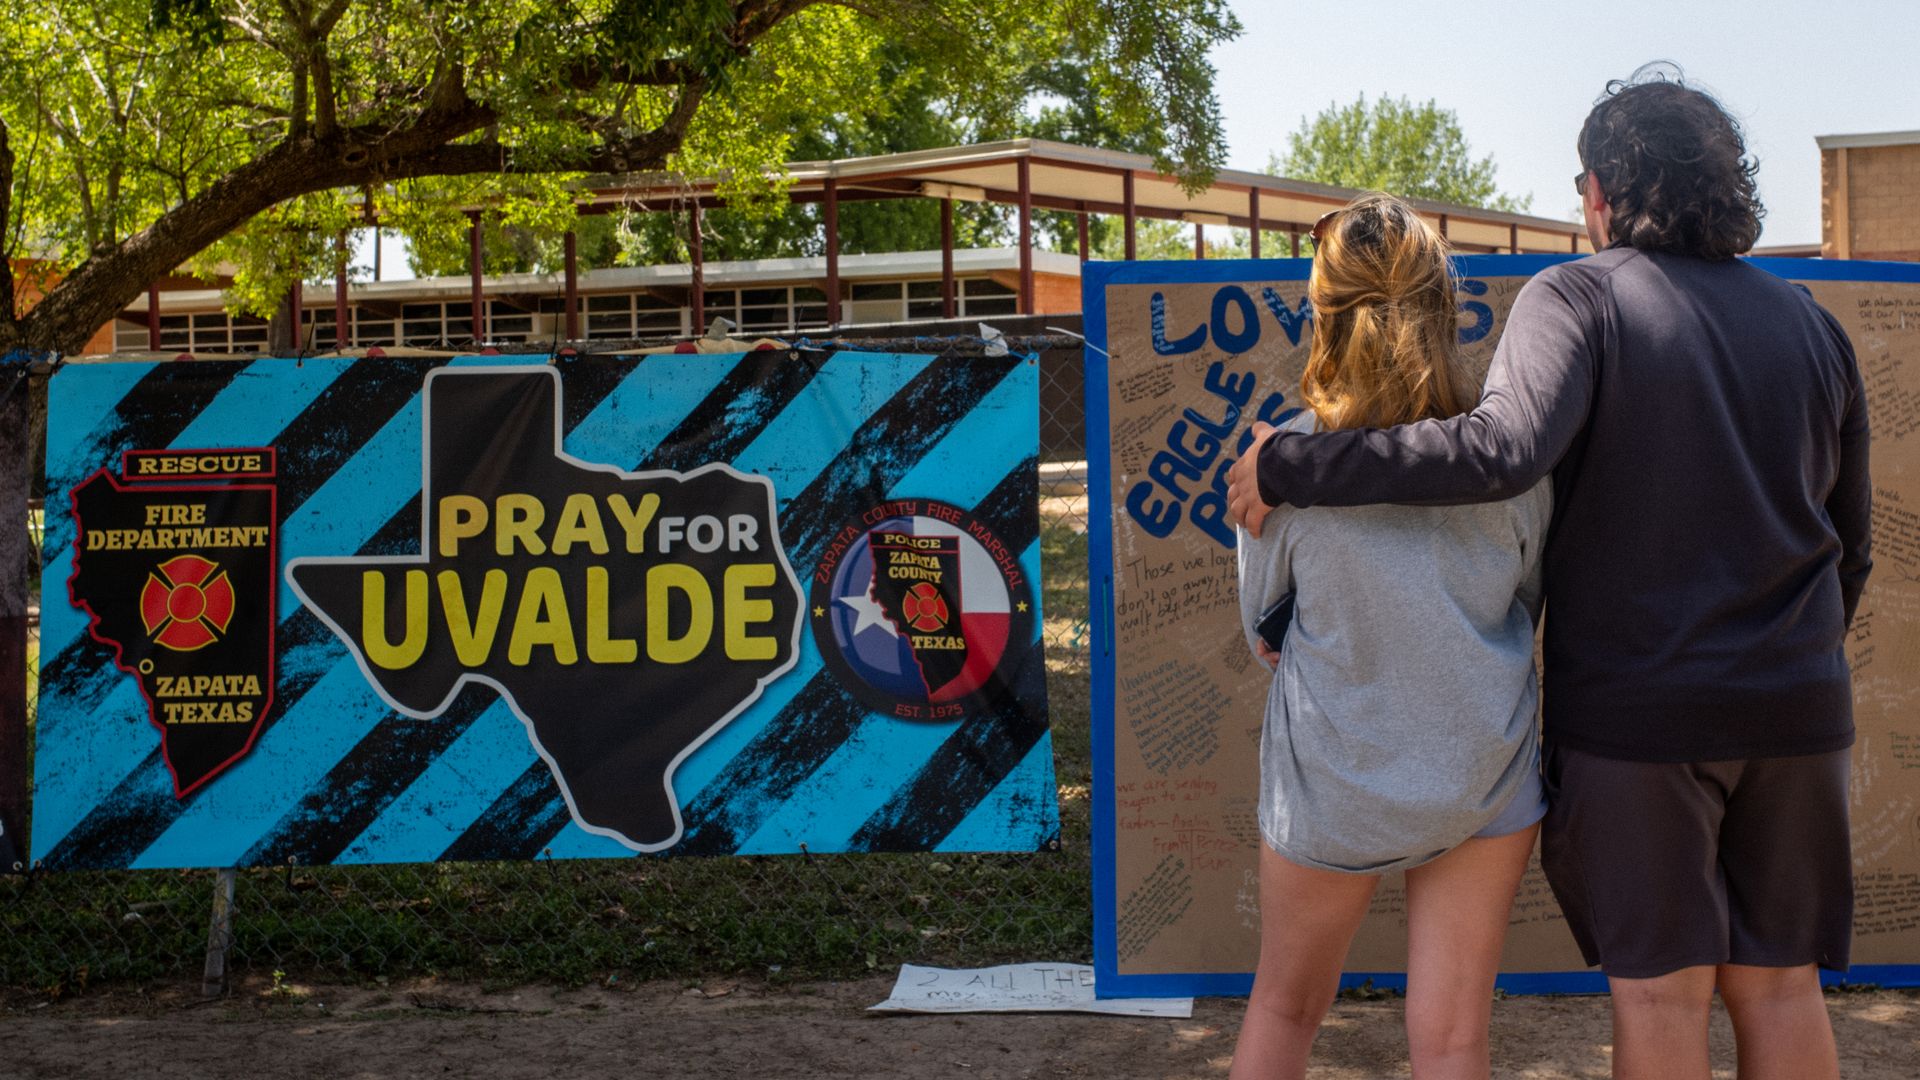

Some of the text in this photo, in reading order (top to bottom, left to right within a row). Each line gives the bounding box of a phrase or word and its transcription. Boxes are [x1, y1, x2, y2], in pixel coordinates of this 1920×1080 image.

[1126, 361, 1256, 539] EAGLE
[138, 455, 262, 475] RESCUE
[145, 504, 207, 526] FIRE
[437, 492, 760, 558] PRAY FOR
[87, 526, 269, 551] DEPARTMENT
[816, 501, 1023, 591] ZAPATA COUNTY FIRE MARSHAL
[884, 534, 941, 549] POLICE
[889, 551, 941, 569] ZAPATA
[1126, 547, 1238, 589] Those we love
[888, 566, 943, 584] COUNTY
[1162, 587, 1177, 604] go
[362, 562, 778, 671] UVALDE
[911, 635, 965, 650] TEXAS
[156, 674, 262, 698] ZAPATA
[164, 702, 254, 725] TEXAS
[895, 703, 963, 718] EST. 1975
[966, 971, 1019, 991] ALL
[1033, 968, 1094, 991] THE
